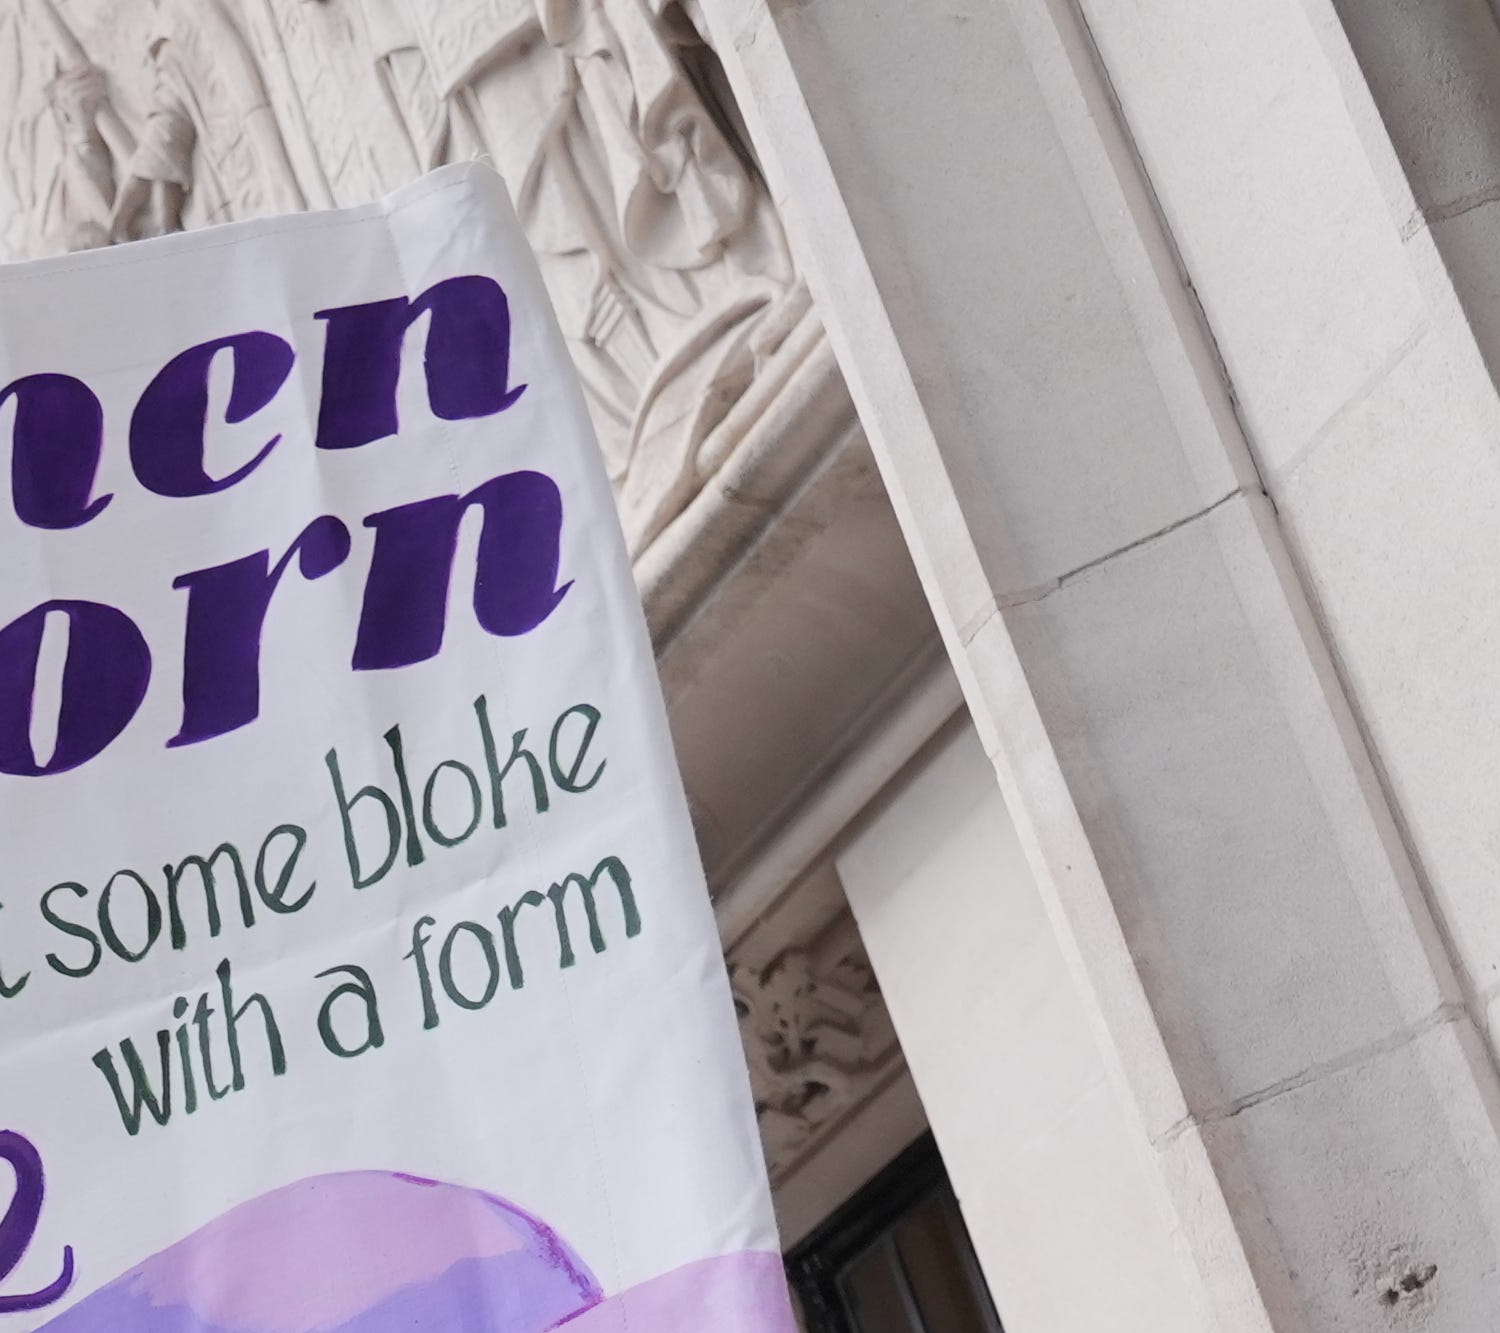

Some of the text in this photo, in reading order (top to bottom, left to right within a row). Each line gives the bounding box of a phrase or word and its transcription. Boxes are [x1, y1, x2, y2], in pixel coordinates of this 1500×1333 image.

[40, 823, 317, 978] some
[326, 694, 607, 890] bloke
[91, 854, 643, 1137] with a form
